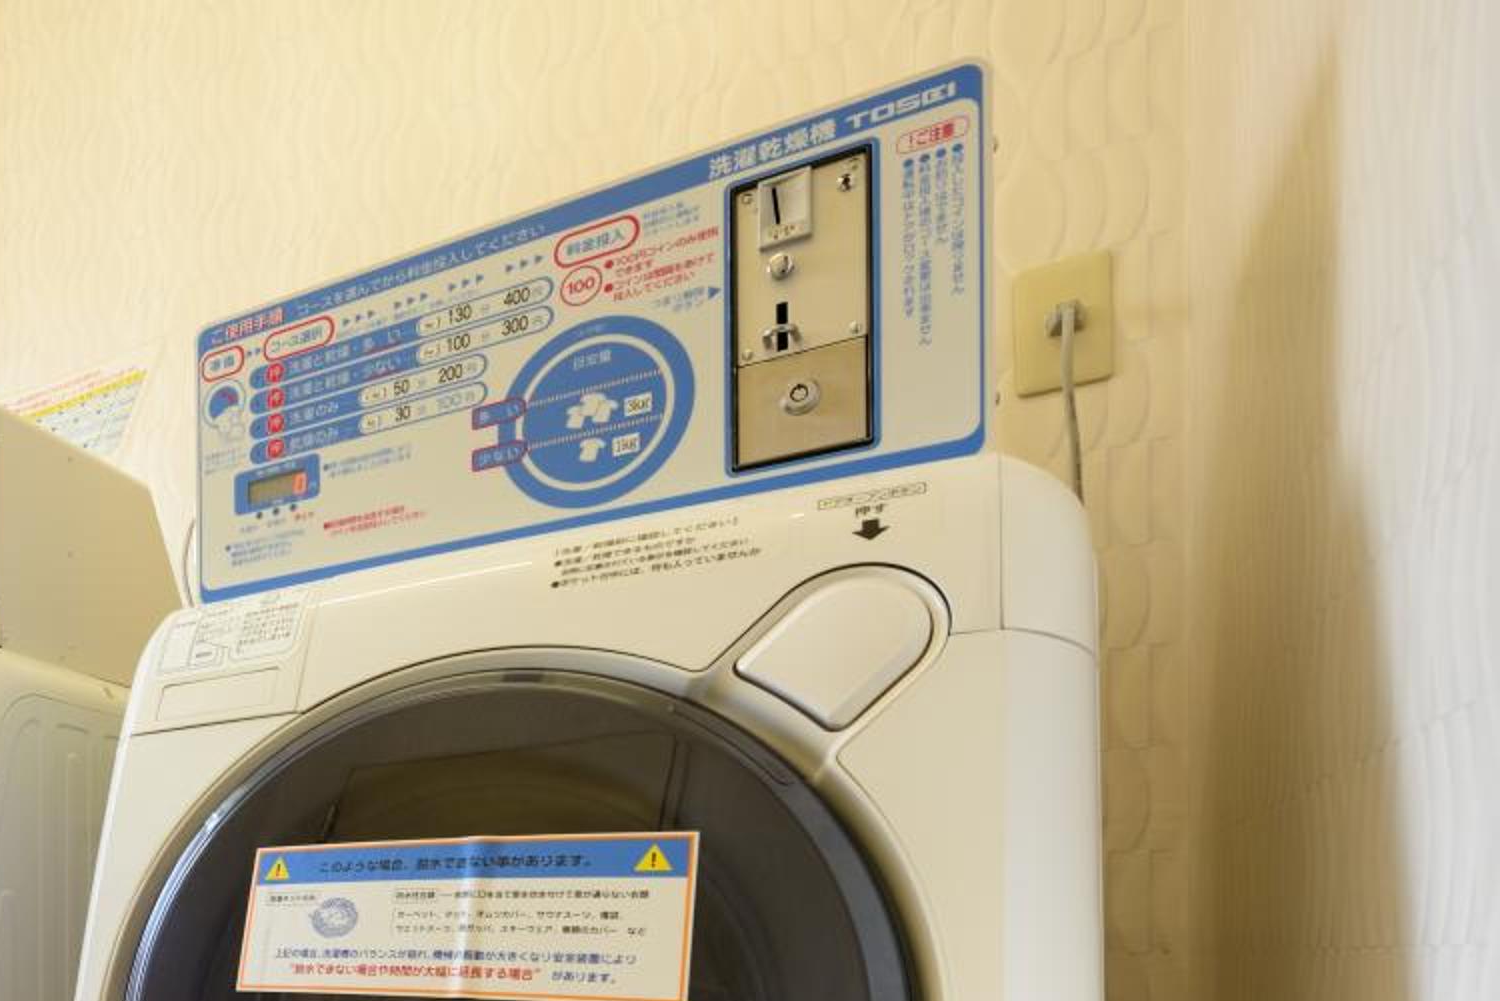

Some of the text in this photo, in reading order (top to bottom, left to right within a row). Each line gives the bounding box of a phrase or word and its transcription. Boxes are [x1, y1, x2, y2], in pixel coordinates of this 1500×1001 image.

[846, 82, 956, 130] TOSEI
[566, 277, 596, 295] 100
[449, 303, 472, 323] 130
[503, 287, 531, 306] 400
[447, 333, 471, 353] 100
[501, 315, 529, 337] 300
[438, 363, 464, 383] 200
[394, 404, 412, 423] 30
